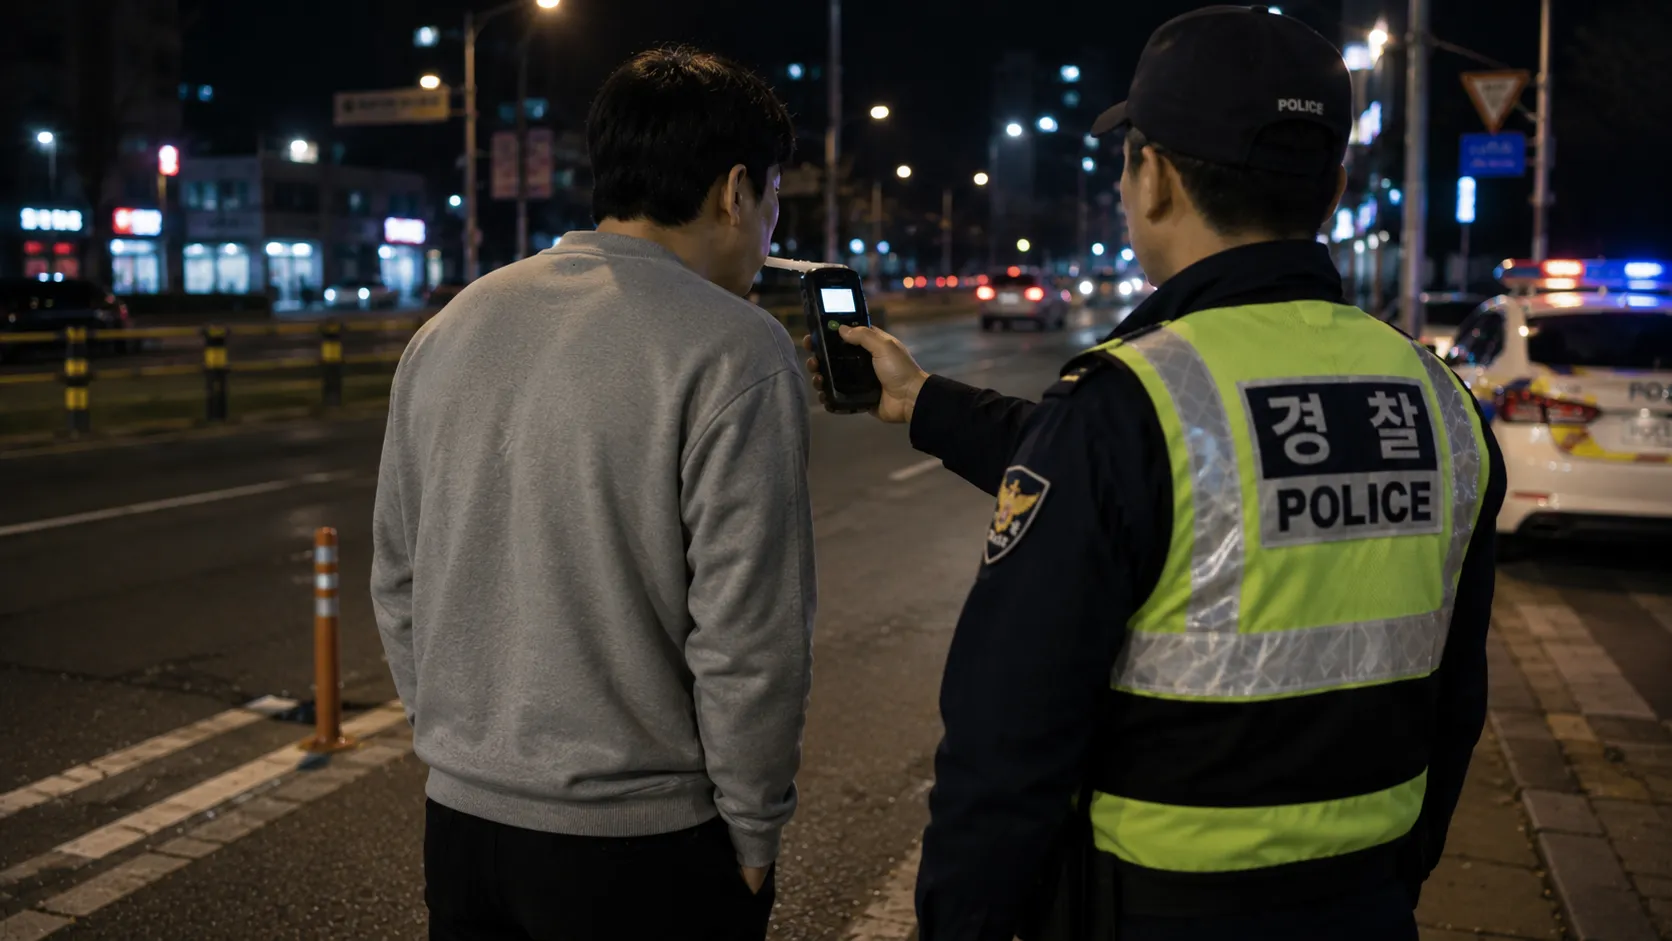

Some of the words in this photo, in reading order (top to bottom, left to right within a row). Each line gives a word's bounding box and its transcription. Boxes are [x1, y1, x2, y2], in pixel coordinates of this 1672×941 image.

[1278, 98, 1324, 115] POLICE
[1267, 391, 1420, 465] 경찰
[1277, 481, 1431, 532] POLICE
